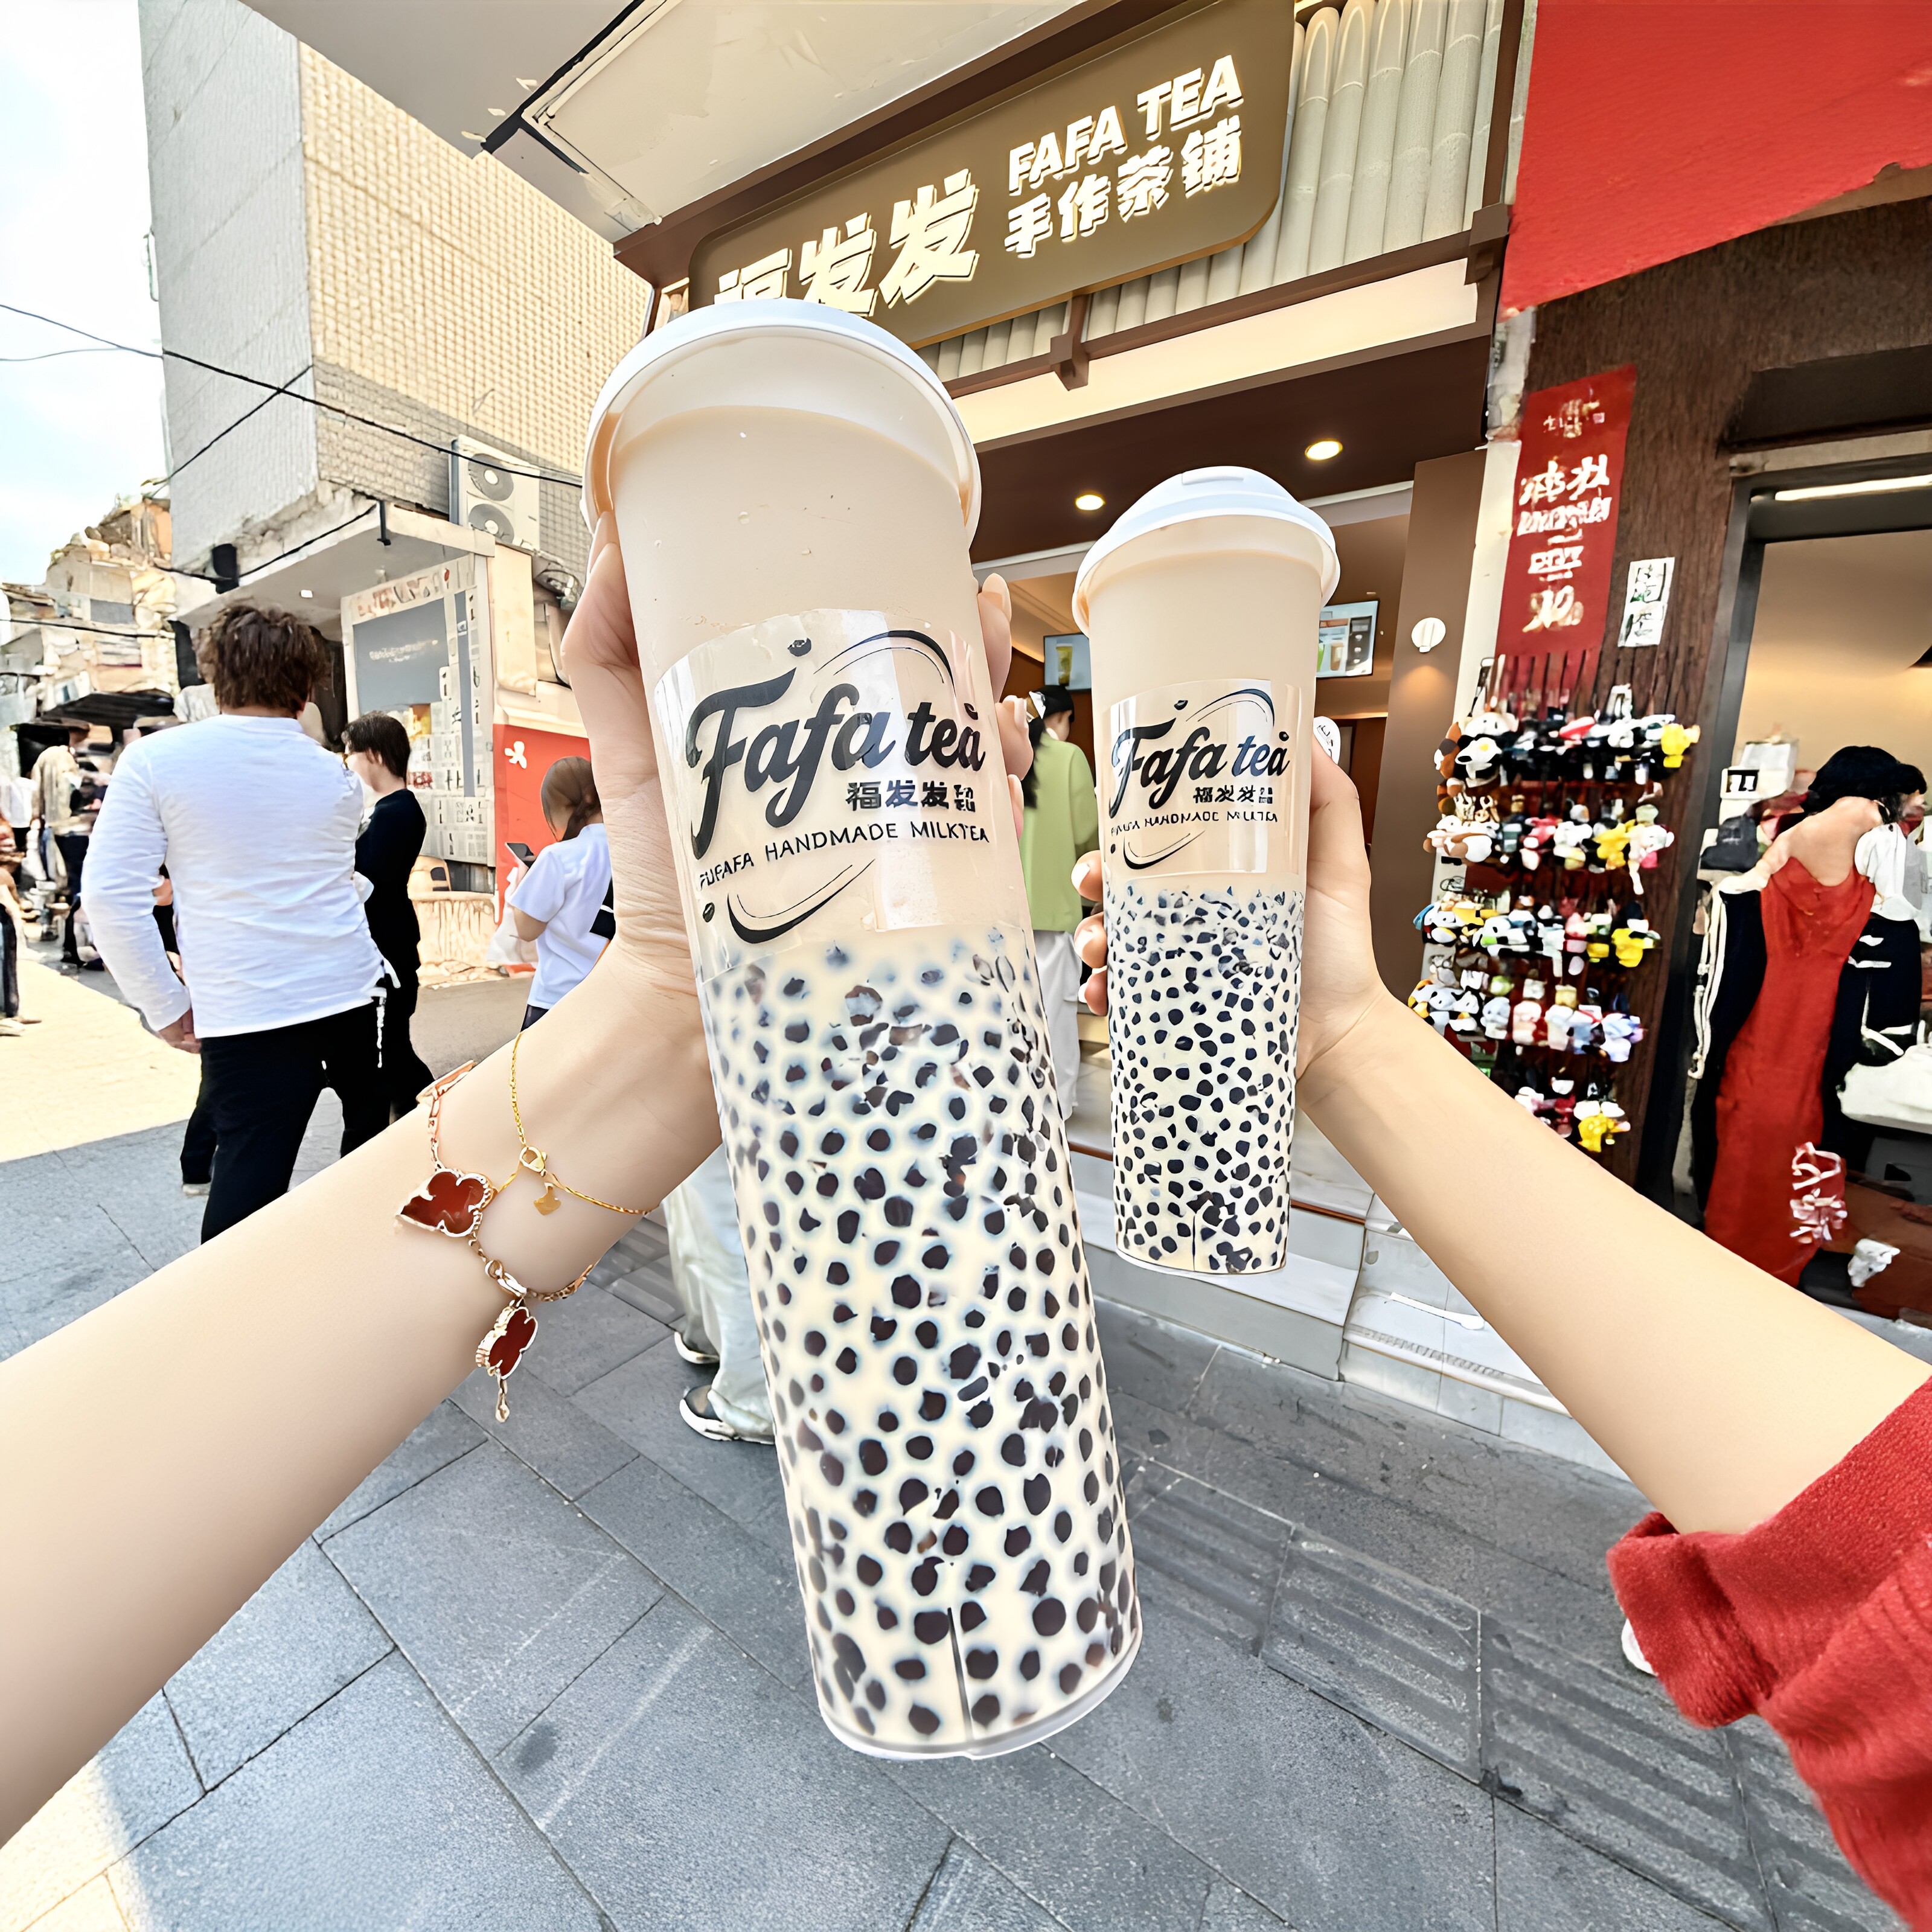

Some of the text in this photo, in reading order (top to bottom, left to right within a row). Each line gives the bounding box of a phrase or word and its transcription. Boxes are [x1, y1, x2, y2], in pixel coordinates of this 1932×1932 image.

[1005, 115, 1241, 258] 手作茶铺
[1009, 55, 1244, 196] FAFA TEA
[685, 667, 985, 860] Fafa tea
[1109, 717, 1290, 819] Fafa tea
[766, 824, 898, 862] HANDMADE
[910, 821, 990, 843] MILKTEA
